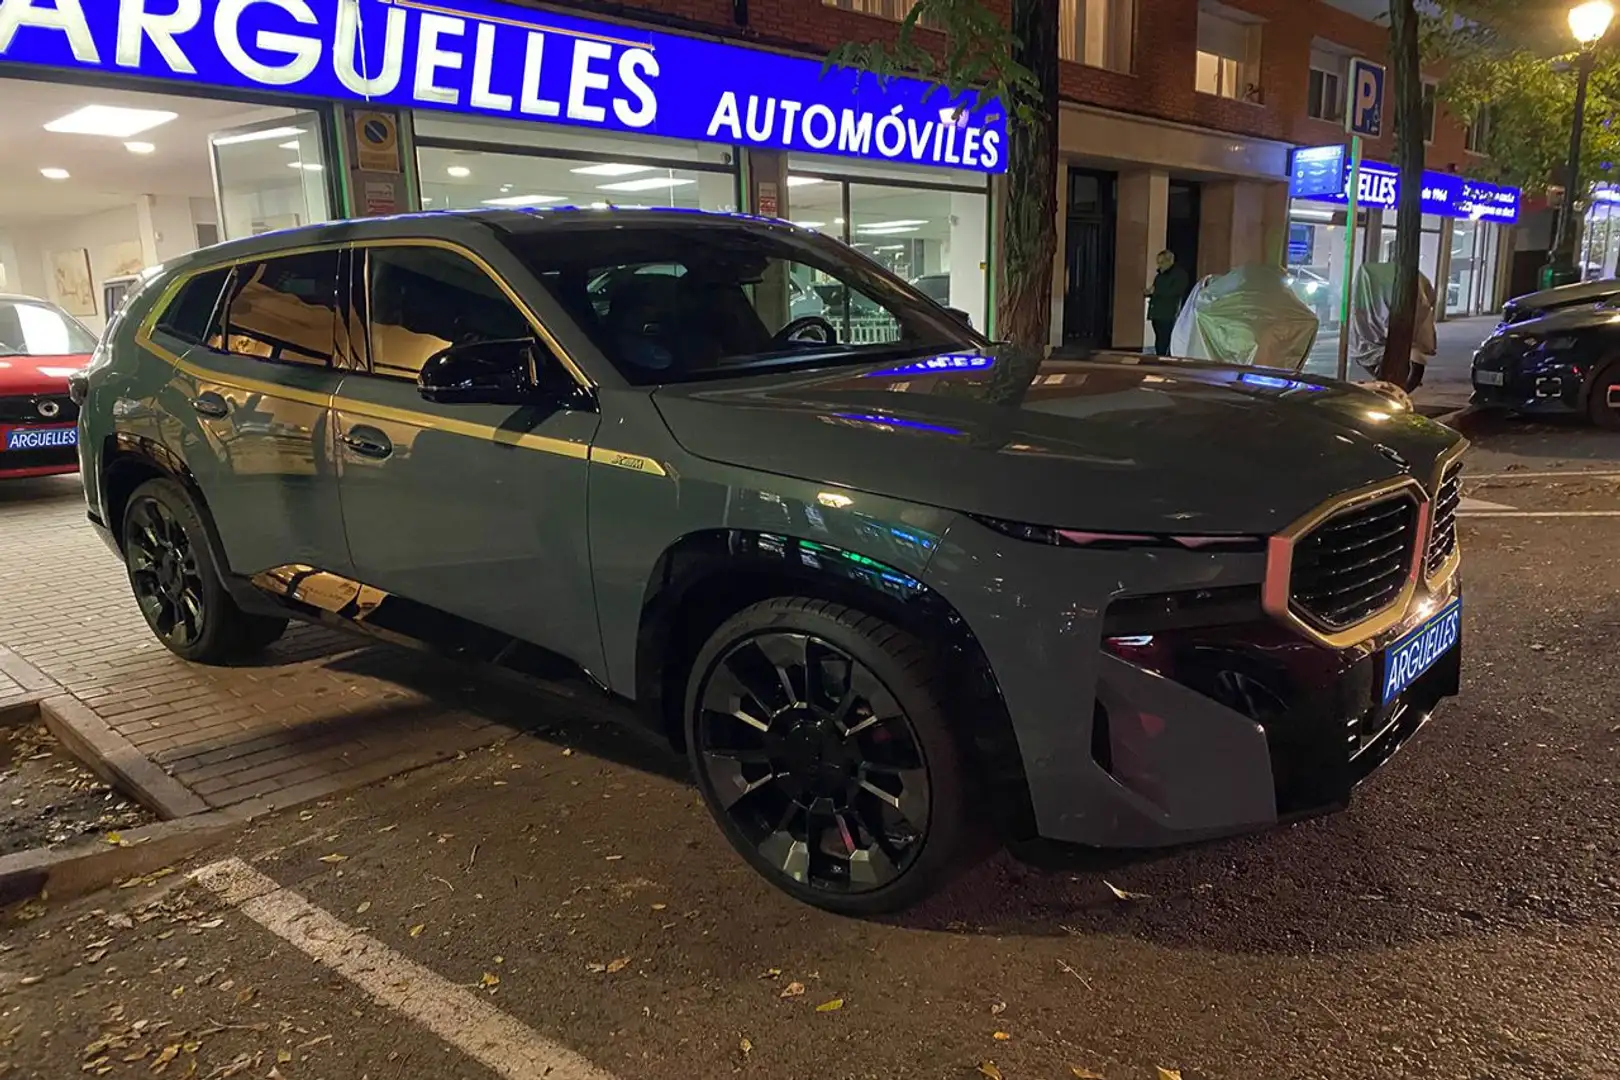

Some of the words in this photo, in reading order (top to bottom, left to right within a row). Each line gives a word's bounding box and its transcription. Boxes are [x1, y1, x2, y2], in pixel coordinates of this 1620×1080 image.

[707, 91, 1000, 168] AUTOMÓVILES
[1355, 68, 1377, 126] P
[9, 430, 76, 448] ARGUELLES
[1385, 610, 1458, 699] ARGUELLES
